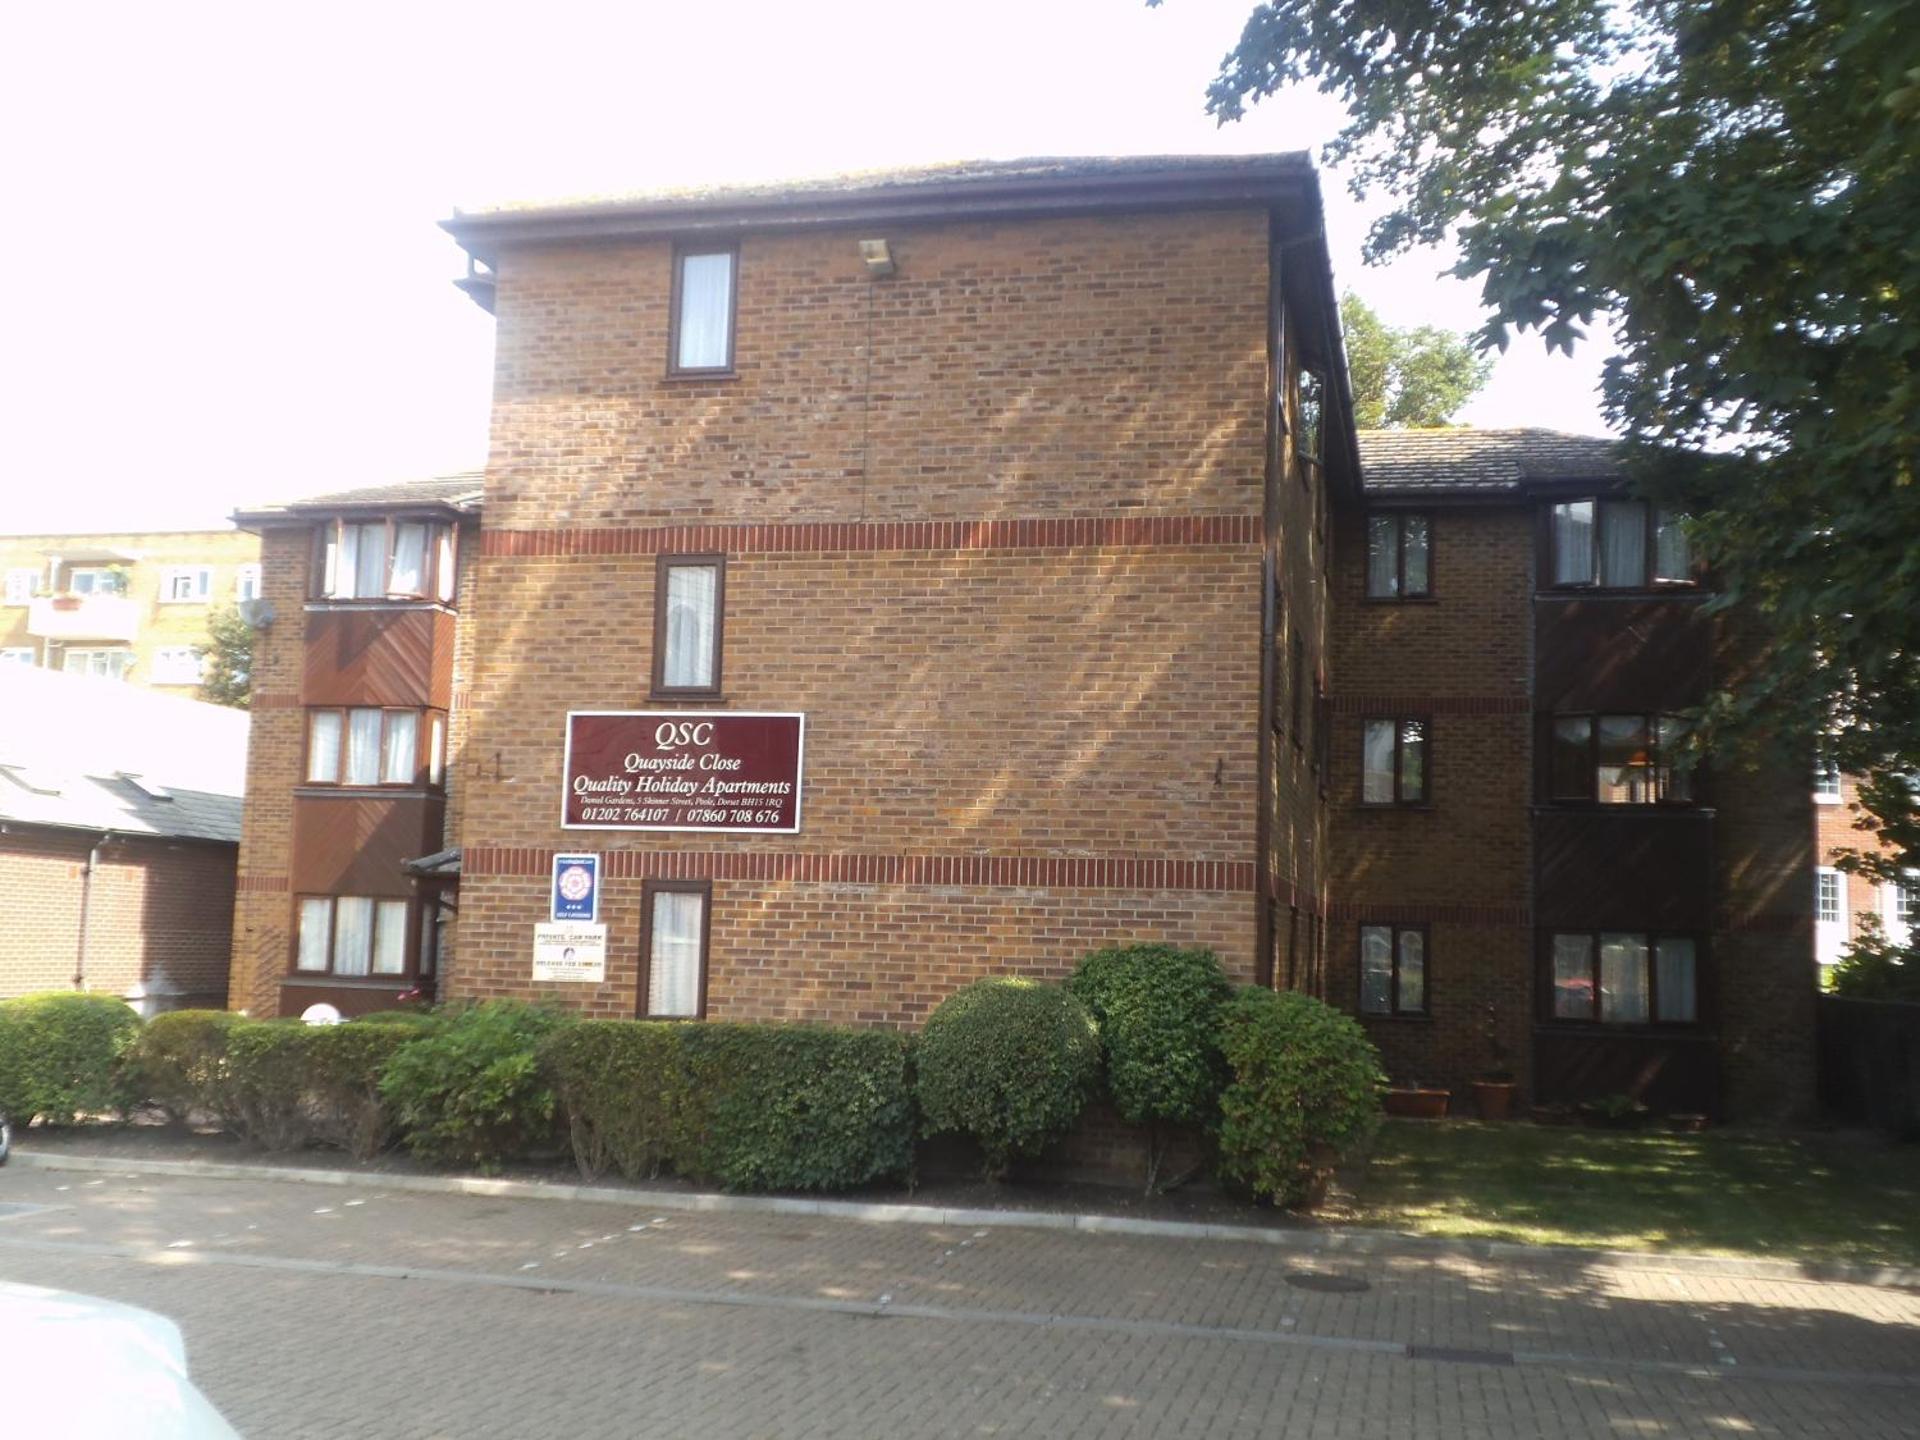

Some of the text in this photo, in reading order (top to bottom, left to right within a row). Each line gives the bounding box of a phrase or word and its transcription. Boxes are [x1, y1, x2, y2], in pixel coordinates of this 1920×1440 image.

[655, 722, 714, 750] QSC
[624, 753, 741, 773] Quayside Close
[573, 775, 791, 796] Quality Holiday Apartments
[717, 798, 739, 806] Dorset
[740, 798, 763, 806] BH15
[764, 798, 783, 808] 1RQ
[582, 808, 619, 821] 01202
[623, 808, 669, 822] 764107
[687, 809, 726, 822] 07860
[729, 809, 752, 822] 708
[755, 810, 780, 823] 676
